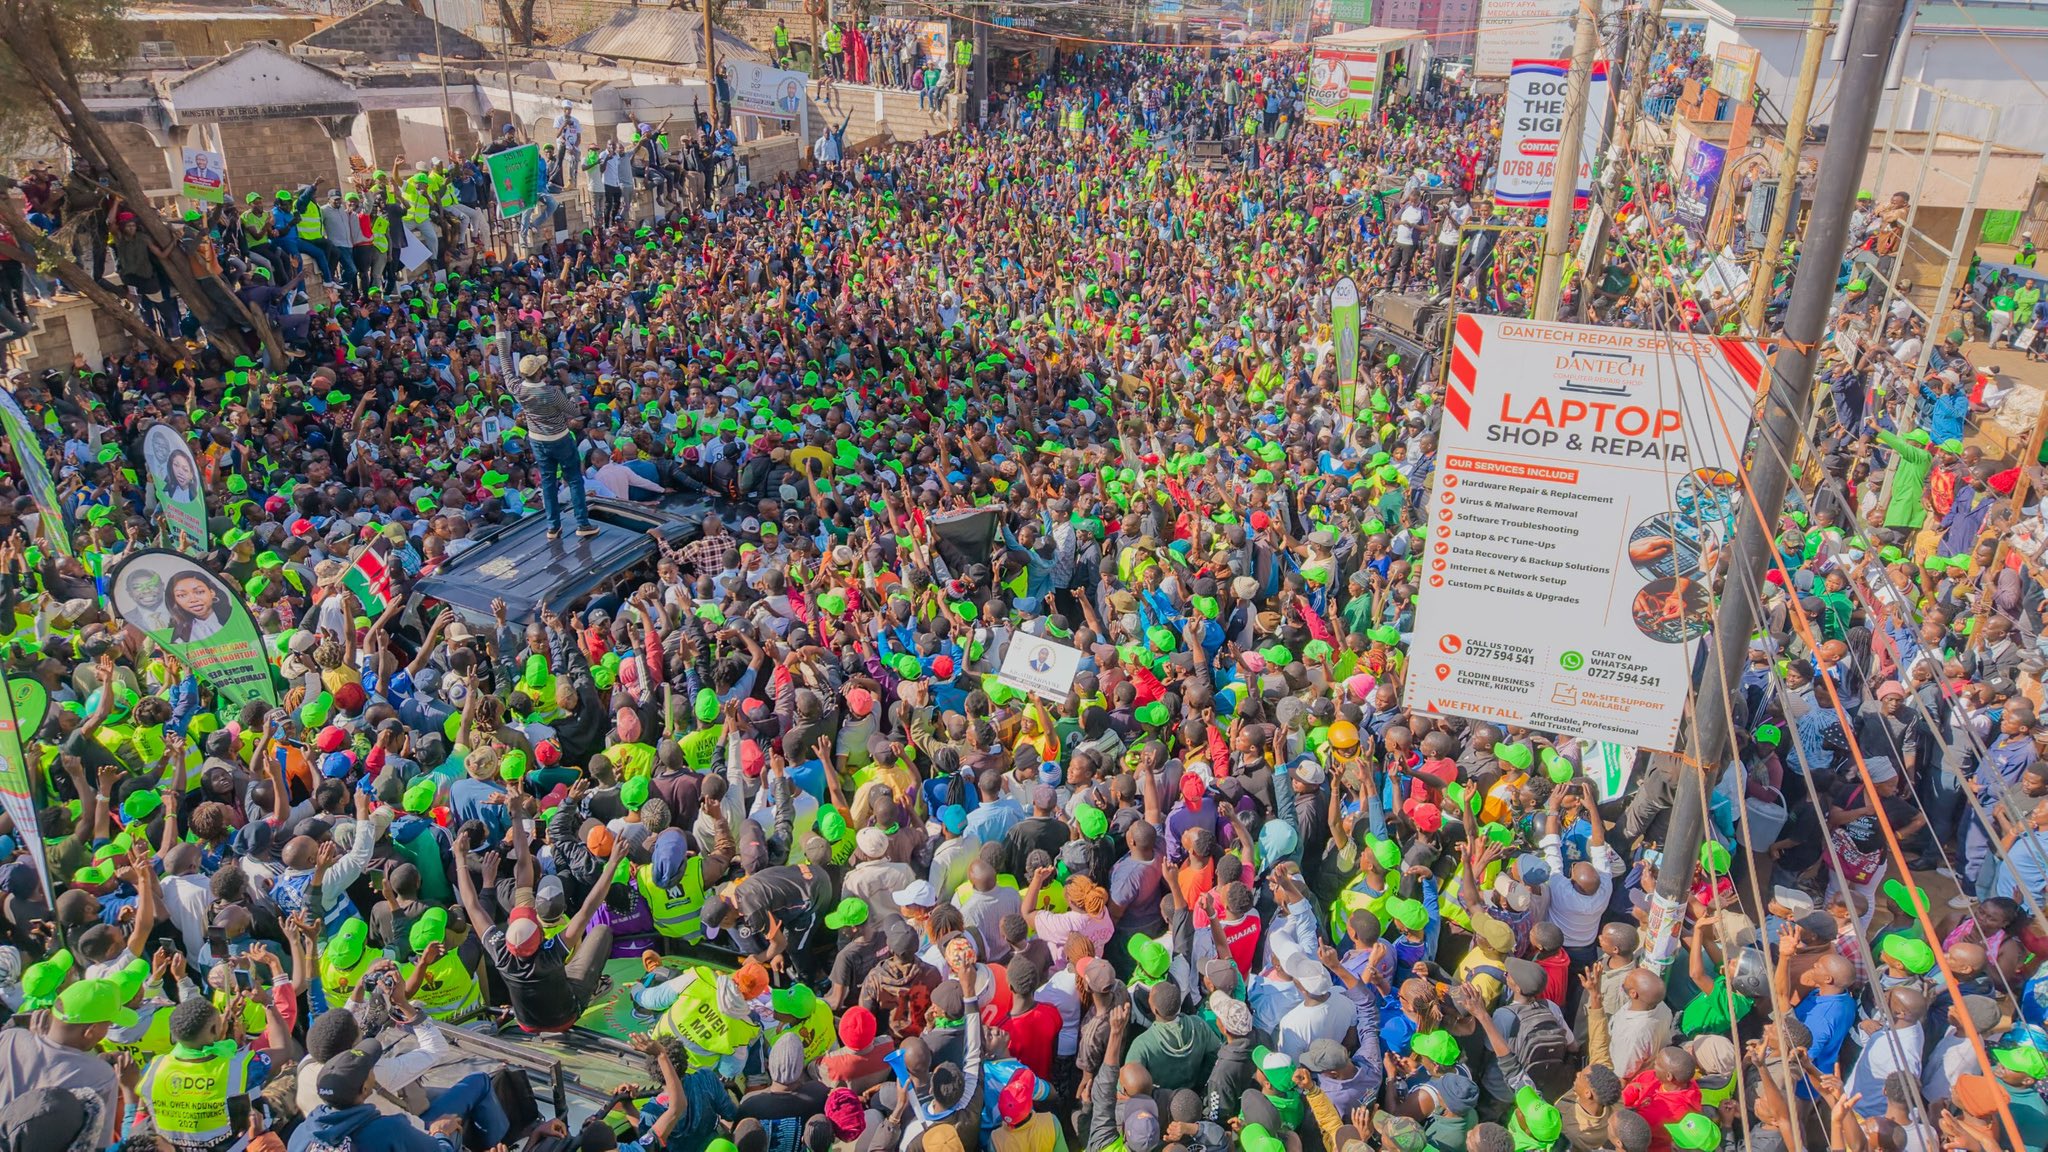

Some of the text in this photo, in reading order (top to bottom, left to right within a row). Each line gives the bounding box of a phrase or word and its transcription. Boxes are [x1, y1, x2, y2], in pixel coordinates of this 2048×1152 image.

[1309, 87, 1350, 99] RIGGY G
[1527, 82, 1568, 96] BOO
[181, 109, 216, 118] MINISTRY
[228, 107, 259, 116] INTERIOR
[1523, 100, 1566, 114] THE
[1517, 118, 1562, 132] SIG
[1502, 160, 1555, 177] 0768 46
[1502, 325, 1713, 354] DANTECH REPAIR SERVICES
[1555, 355, 1646, 377] DANTECH
[1553, 373, 1643, 386] COMPUTER REPAIR SHOP
[1499, 392, 1683, 439] LAPTOP
[1486, 424, 1689, 463] SHOP & REPAIR
[1449, 458, 1575, 481] OUR SERVICES INCLUDE
[1461, 479, 1507, 491] Hardware
[1508, 485, 1540, 496] Repair
[1550, 489, 1614, 504] Replacement
[1460, 496, 1484, 507] Virus
[1494, 501, 1535, 513] Malware
[1536, 506, 1578, 518] Removal
[1457, 513, 1579, 537] Software Troubleshooting
[1455, 530, 1487, 541] Laptop
[1497, 535, 1509, 543] PC
[1511, 537, 1556, 550] Tune-Ups
[1452, 546, 1474, 556] Data
[1475, 550, 1519, 563] Recovery
[1529, 556, 1564, 569] Backup
[1565, 561, 1610, 574] Solutions
[1450, 563, 1567, 586] Internet & Network Setup
[1448, 579, 1482, 591] Custom
[1483, 584, 1496, 592] PC
[1497, 586, 1525, 597] Builds
[1535, 591, 1580, 604] Upgrades
[1465, 646, 1535, 666] 0727 594 541
[1467, 639, 1533, 655] CALL US TODAY
[1591, 649, 1632, 662] CHAT ON
[1590, 658, 1648, 673] WHATSAPP
[1457, 677, 1529, 694] CENTRE, KIKUYU
[1458, 669, 1535, 688] FLODIN BUSINESS
[1587, 667, 1661, 688] 0727 594 541
[1438, 698, 1523, 720] WE FIX IT ALL.
[1580, 698, 1631, 713] AVAILABLE
[1582, 691, 1664, 711] ON-SITE SUPPORT
[1529, 718, 1584, 734] and Trusted.
[1530, 711, 1639, 736] Affordable, Professional
[1226, 924, 1257, 944] SHAJAR
[690, 1018, 713, 1040] MP
[698, 1003, 729, 1037] OWEN
[677, 1023, 695, 1042] KIK
[184, 1077, 215, 1090] DCP
[162, 1110, 182, 1119] KIKUYU
[182, 1109, 226, 1119] CONSTITUENCY
[178, 1120, 199, 1129] 2027
